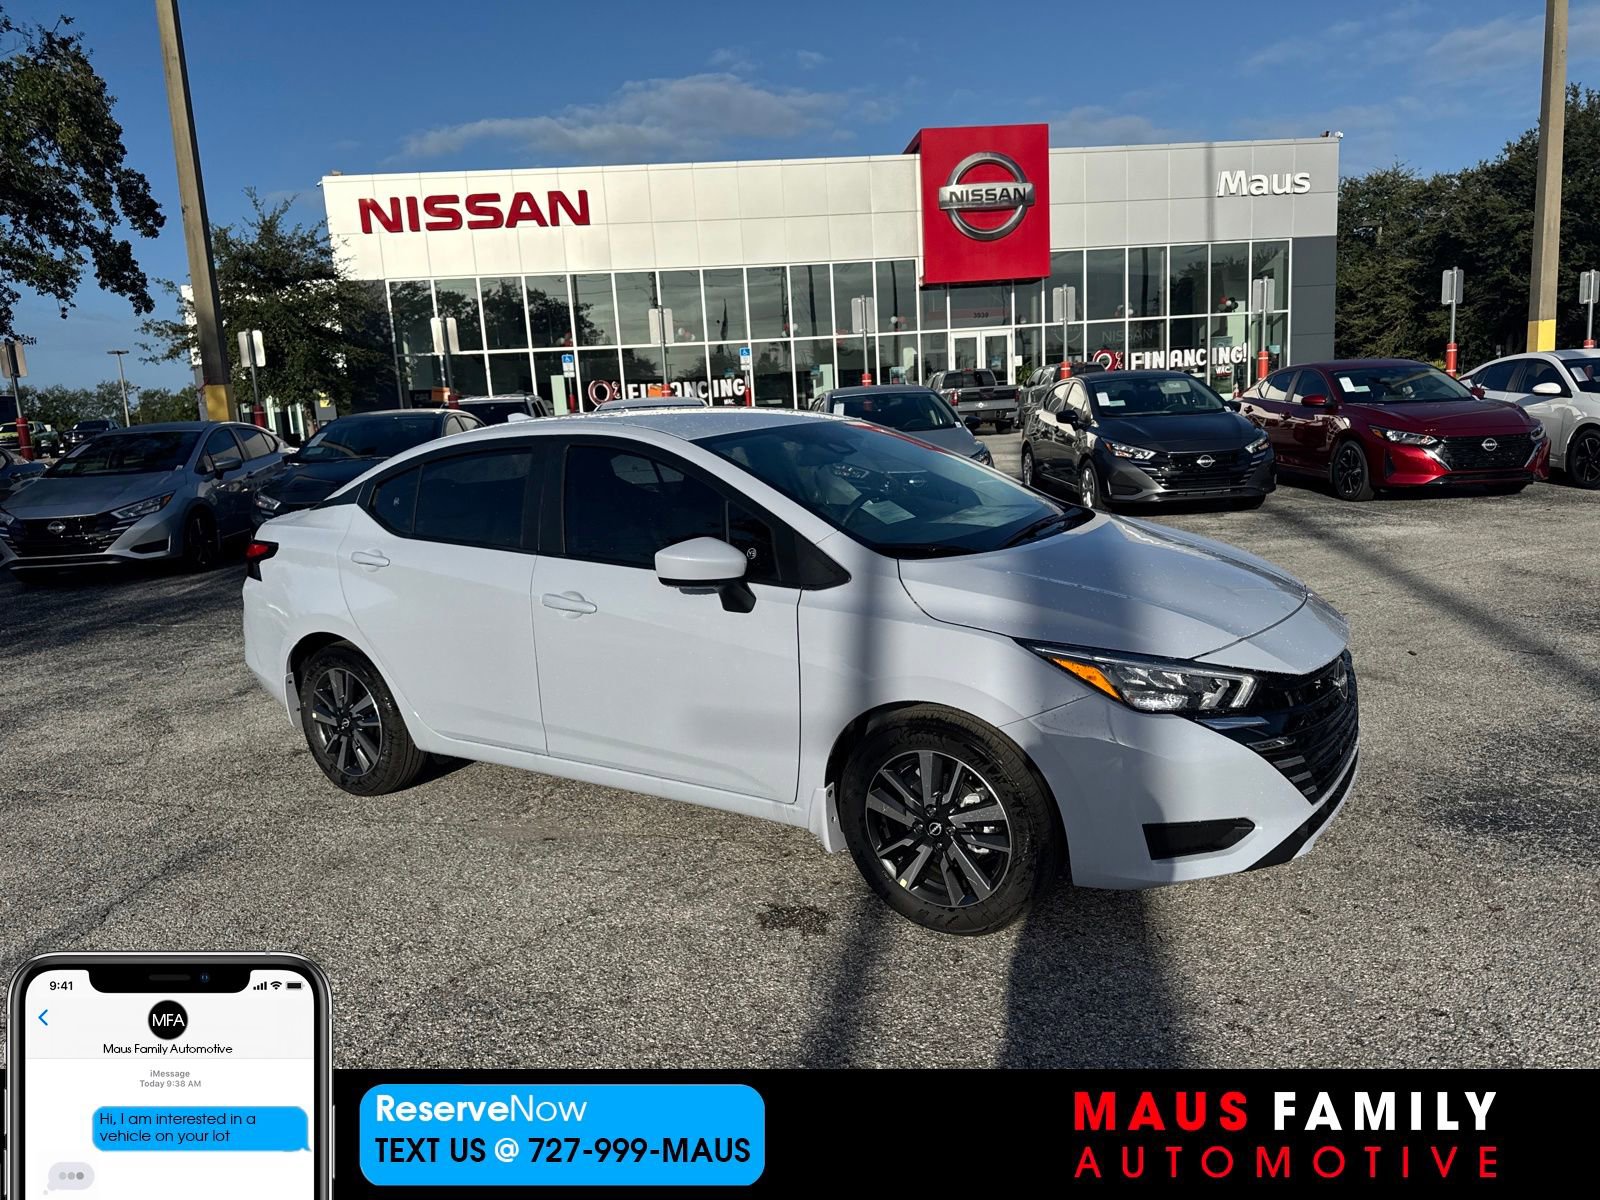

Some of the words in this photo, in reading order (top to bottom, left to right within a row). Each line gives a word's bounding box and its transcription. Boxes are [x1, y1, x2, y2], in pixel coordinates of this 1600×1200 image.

[949, 187, 1026, 203] NISSAN
[1216, 170, 1311, 197] Maus
[358, 190, 590, 234] NISSAN
[1131, 343, 1248, 370] FINANCING!
